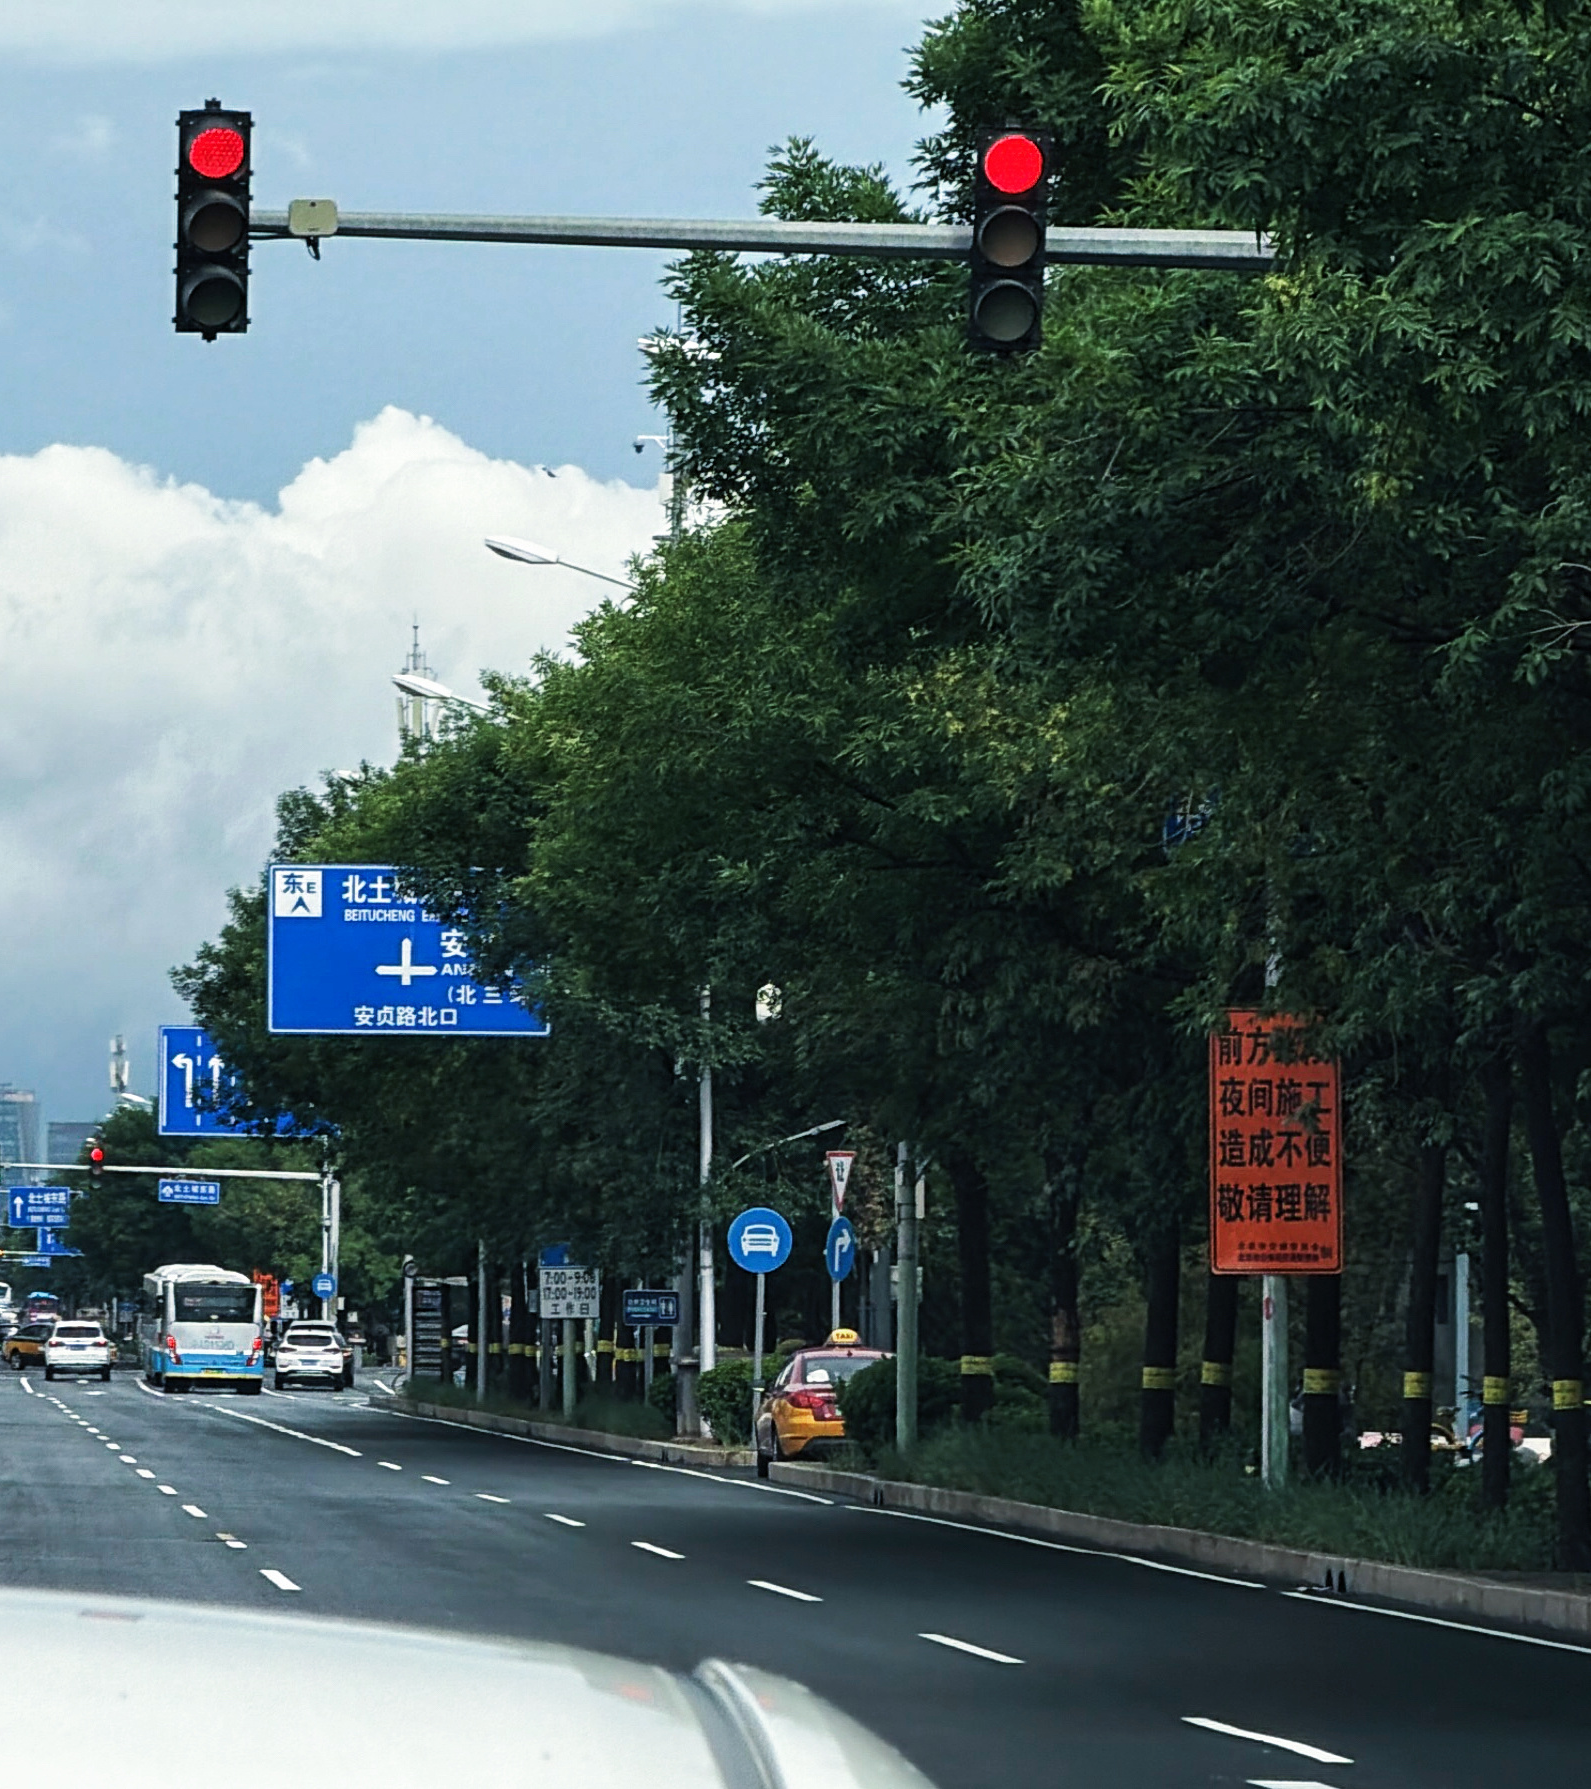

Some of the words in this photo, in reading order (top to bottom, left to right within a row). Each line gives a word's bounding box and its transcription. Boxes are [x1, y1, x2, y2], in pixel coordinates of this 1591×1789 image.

[282, 873, 304, 894] 东
[306, 881, 317, 894] E
[344, 908, 416, 922] BEITUCHENG
[354, 1005, 458, 1026] 安贞路北口
[1218, 1026, 1331, 1066] 前方
[1218, 1077, 1332, 1118] 夜间施工
[1218, 1127, 1331, 1168] 造成不便
[1216, 1182, 1331, 1223] 敬请理解
[551, 1301, 590, 1316] 工作日
